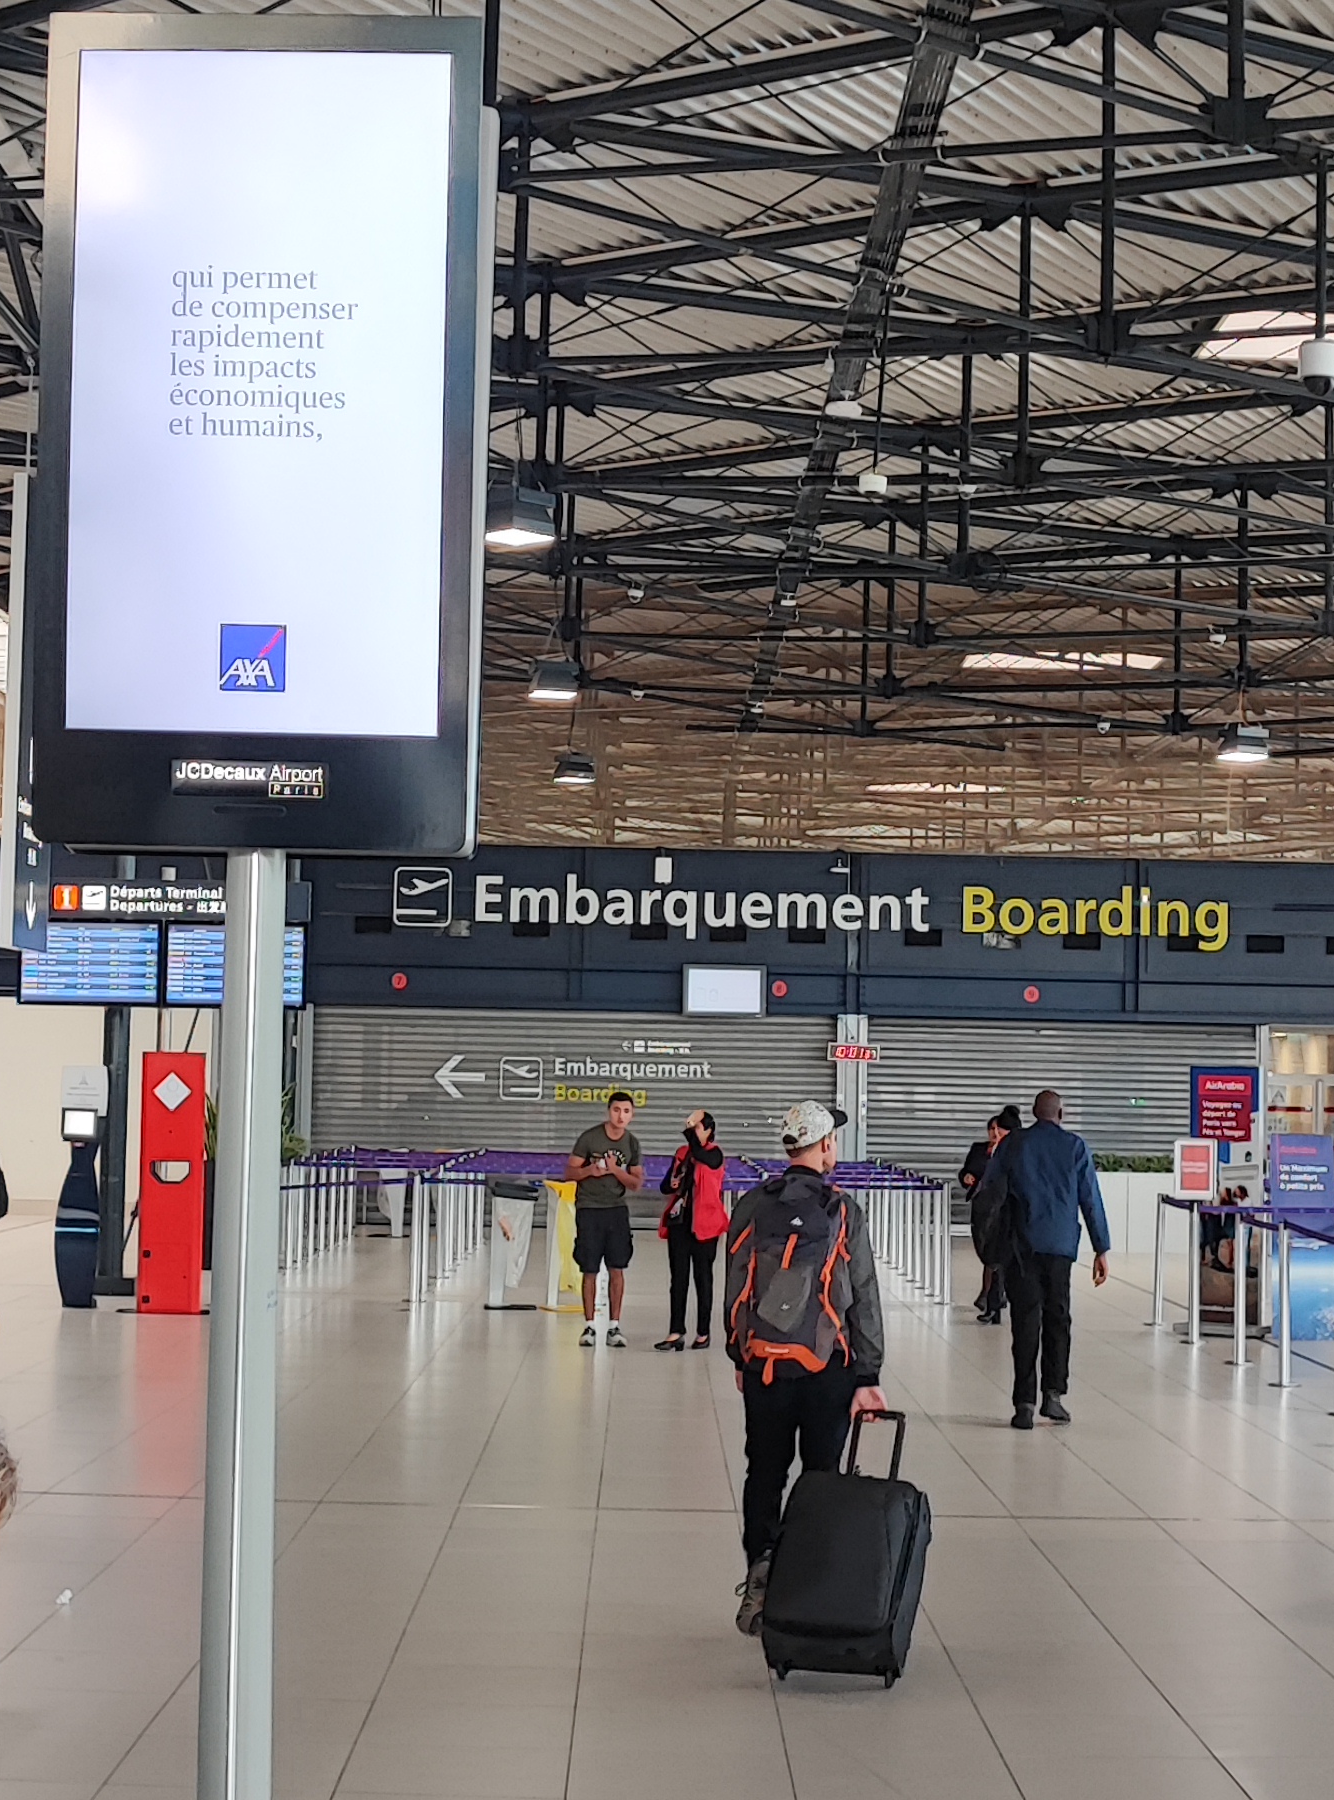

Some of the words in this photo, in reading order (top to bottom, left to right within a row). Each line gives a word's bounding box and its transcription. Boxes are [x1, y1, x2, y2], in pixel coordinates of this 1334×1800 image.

[171, 264, 214, 295] qui
[221, 269, 318, 295] permet
[171, 293, 203, 317] de
[211, 300, 359, 325] compenser
[170, 324, 325, 353] rapidement
[169, 352, 205, 377] les
[213, 354, 318, 384] impacts
[169, 382, 346, 415] économiques
[168, 414, 194, 436] et
[200, 411, 323, 443] humains,
[220, 657, 276, 687] AXA
[175, 761, 267, 781] JCDecaux
[268, 763, 324, 784] Airport
[272, 783, 320, 796] Paris
[109, 883, 163, 900] Départs
[165, 885, 224, 900] Terminal
[109, 900, 184, 914] Departures
[473, 873, 931, 941] Embarquement
[961, 884, 1230, 952] Boarding
[552, 1056, 713, 1081] Embarquement
